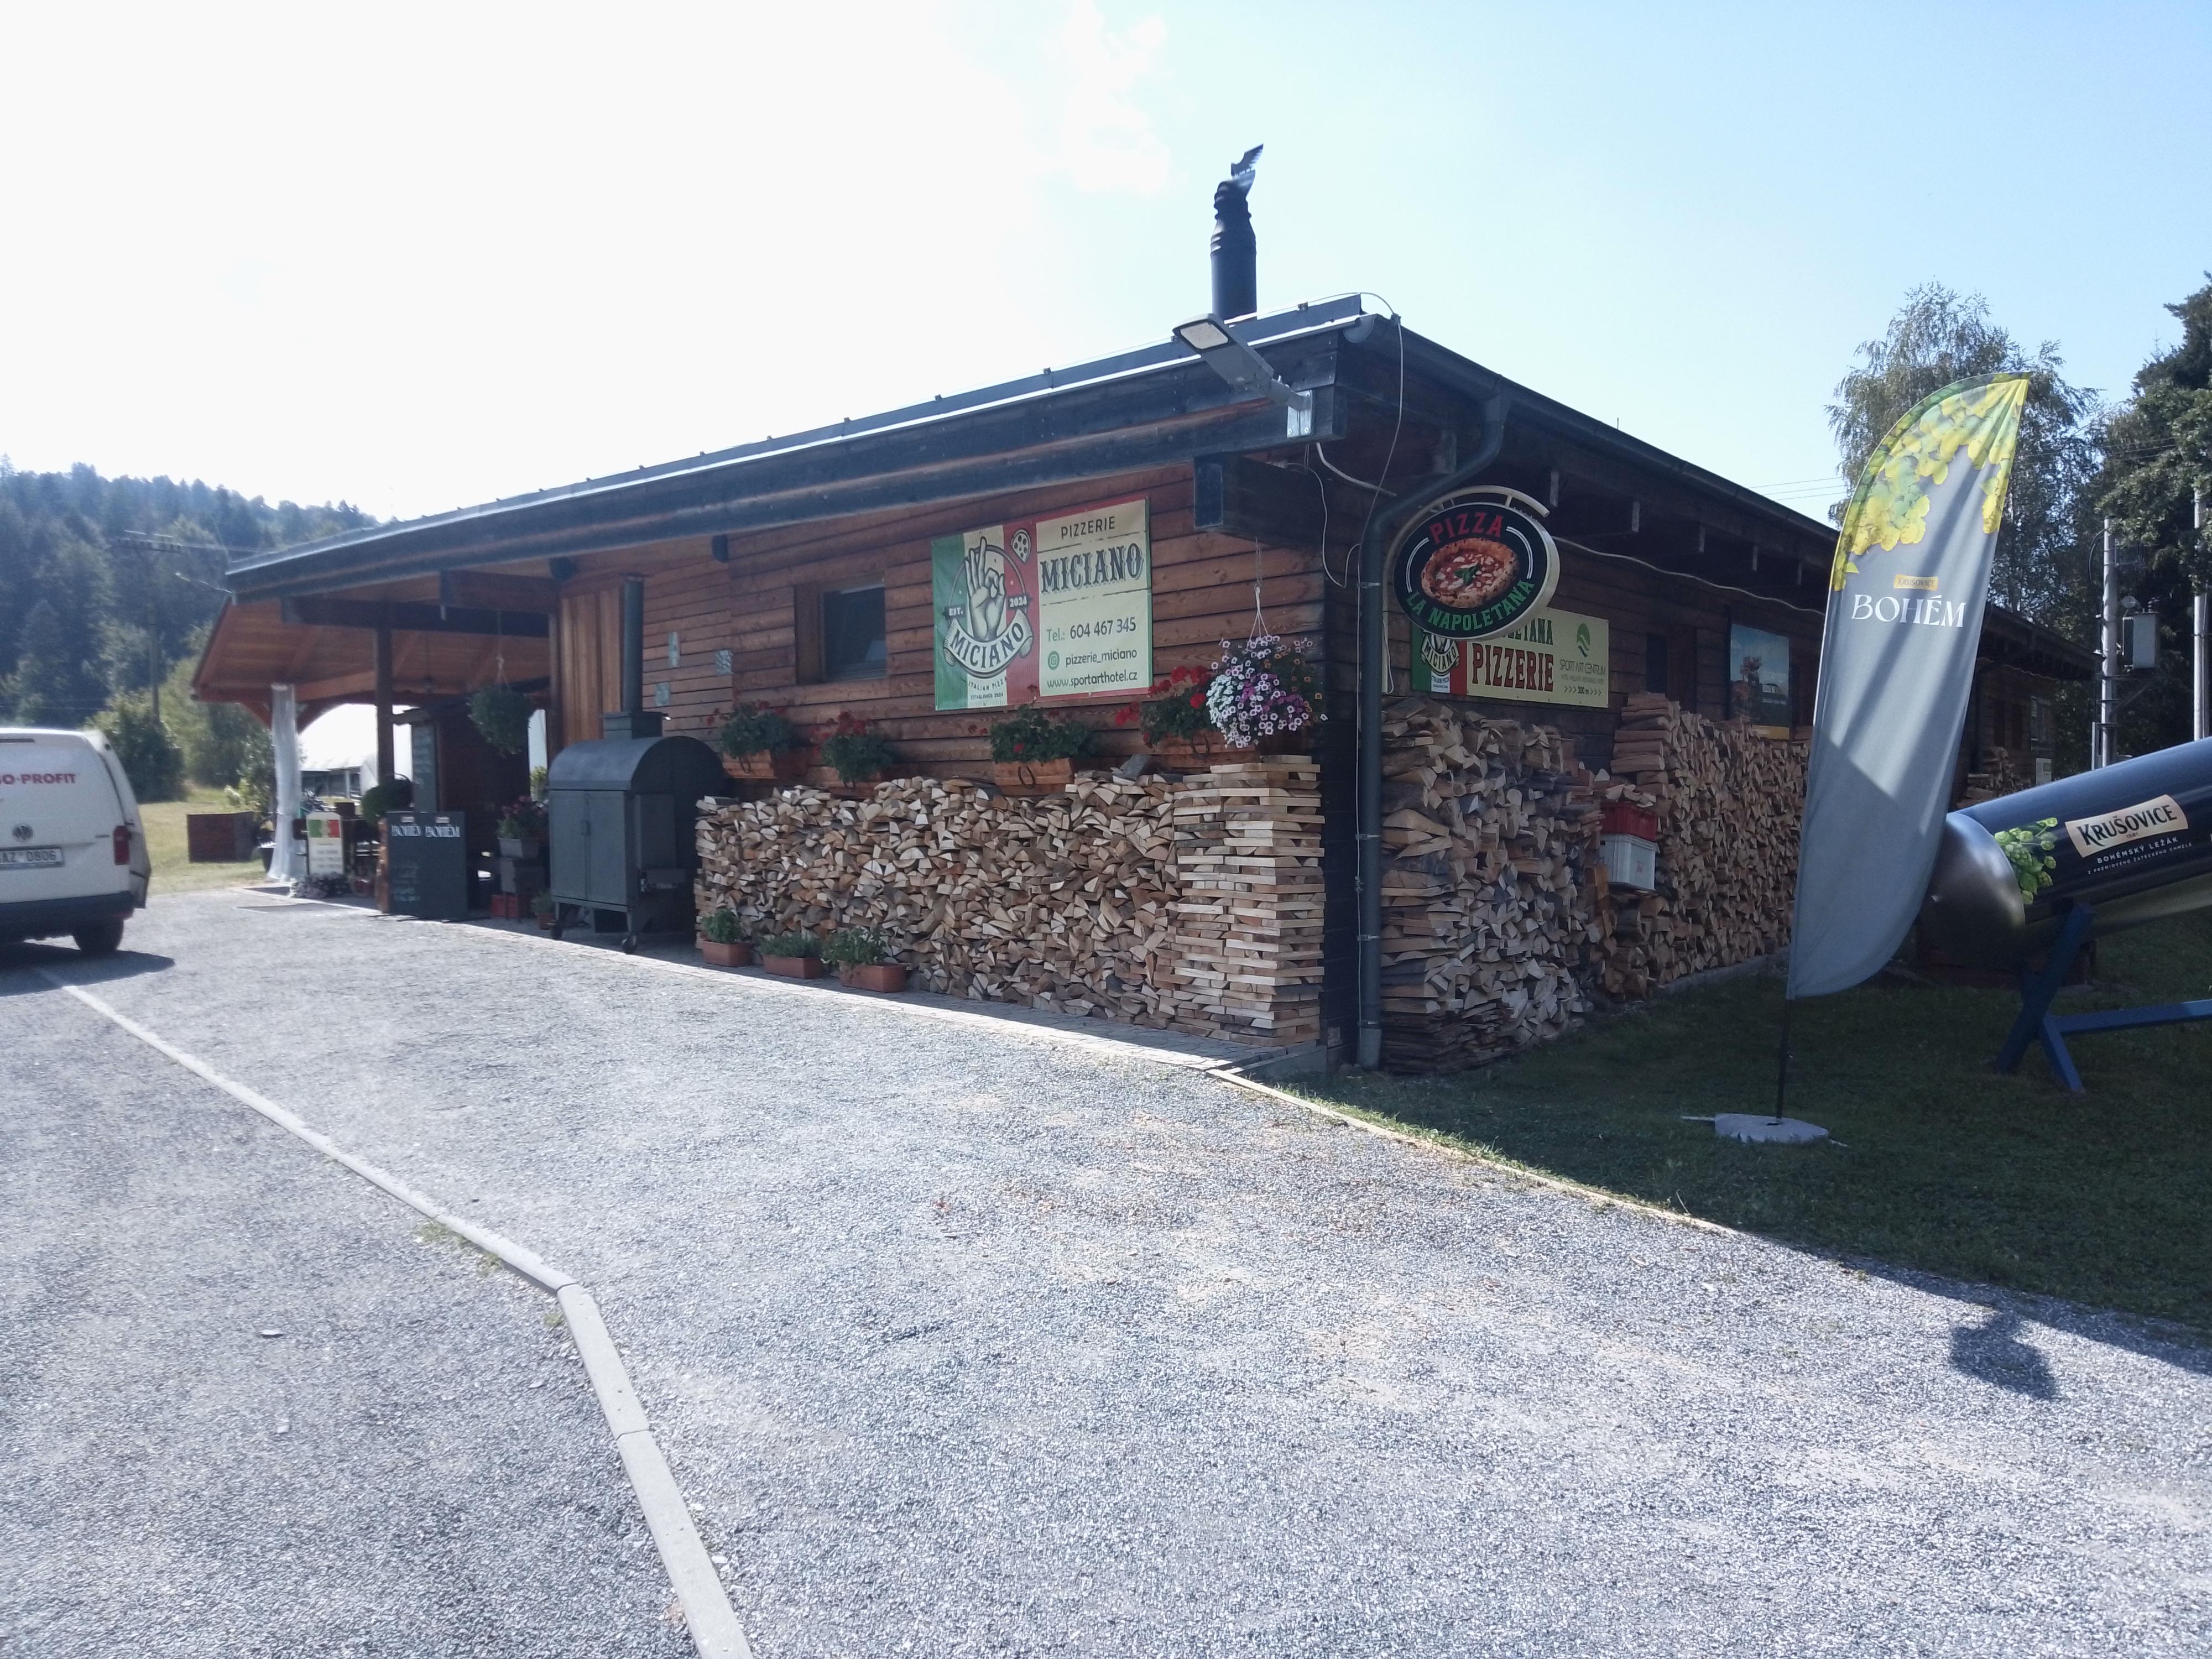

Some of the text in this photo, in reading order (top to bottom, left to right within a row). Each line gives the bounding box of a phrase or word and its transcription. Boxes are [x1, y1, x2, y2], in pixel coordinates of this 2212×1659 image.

[1061, 516, 1115, 539] PIZZERIE
[1429, 512, 1504, 544] PIZZA
[1040, 542, 1144, 594] MICIANO
[1009, 596, 1027, 608] 2024
[1406, 580, 1535, 631] LA NAPOLETANA
[1851, 594, 1966, 628] BOHÉM
[1047, 617, 1136, 642] Tel.: 604 467 345
[950, 623, 1024, 669] MICIANO
[1066, 649, 1137, 667] pizzerie_miciano
[1424, 641, 1457, 670] MICIANO
[1047, 669, 1138, 688] www.sportarthotel.cz
[1472, 643, 1554, 692] PIZZERIE
[968, 681, 990, 691] ITALIAN
[0, 774, 76, 785] O-PROFIT
[2077, 805, 2178, 847] KRUŠOVICE
[1, 852, 17, 863] AZ
[2096, 836, 2178, 864] BOHÉMSKÝ LEŽÁK
